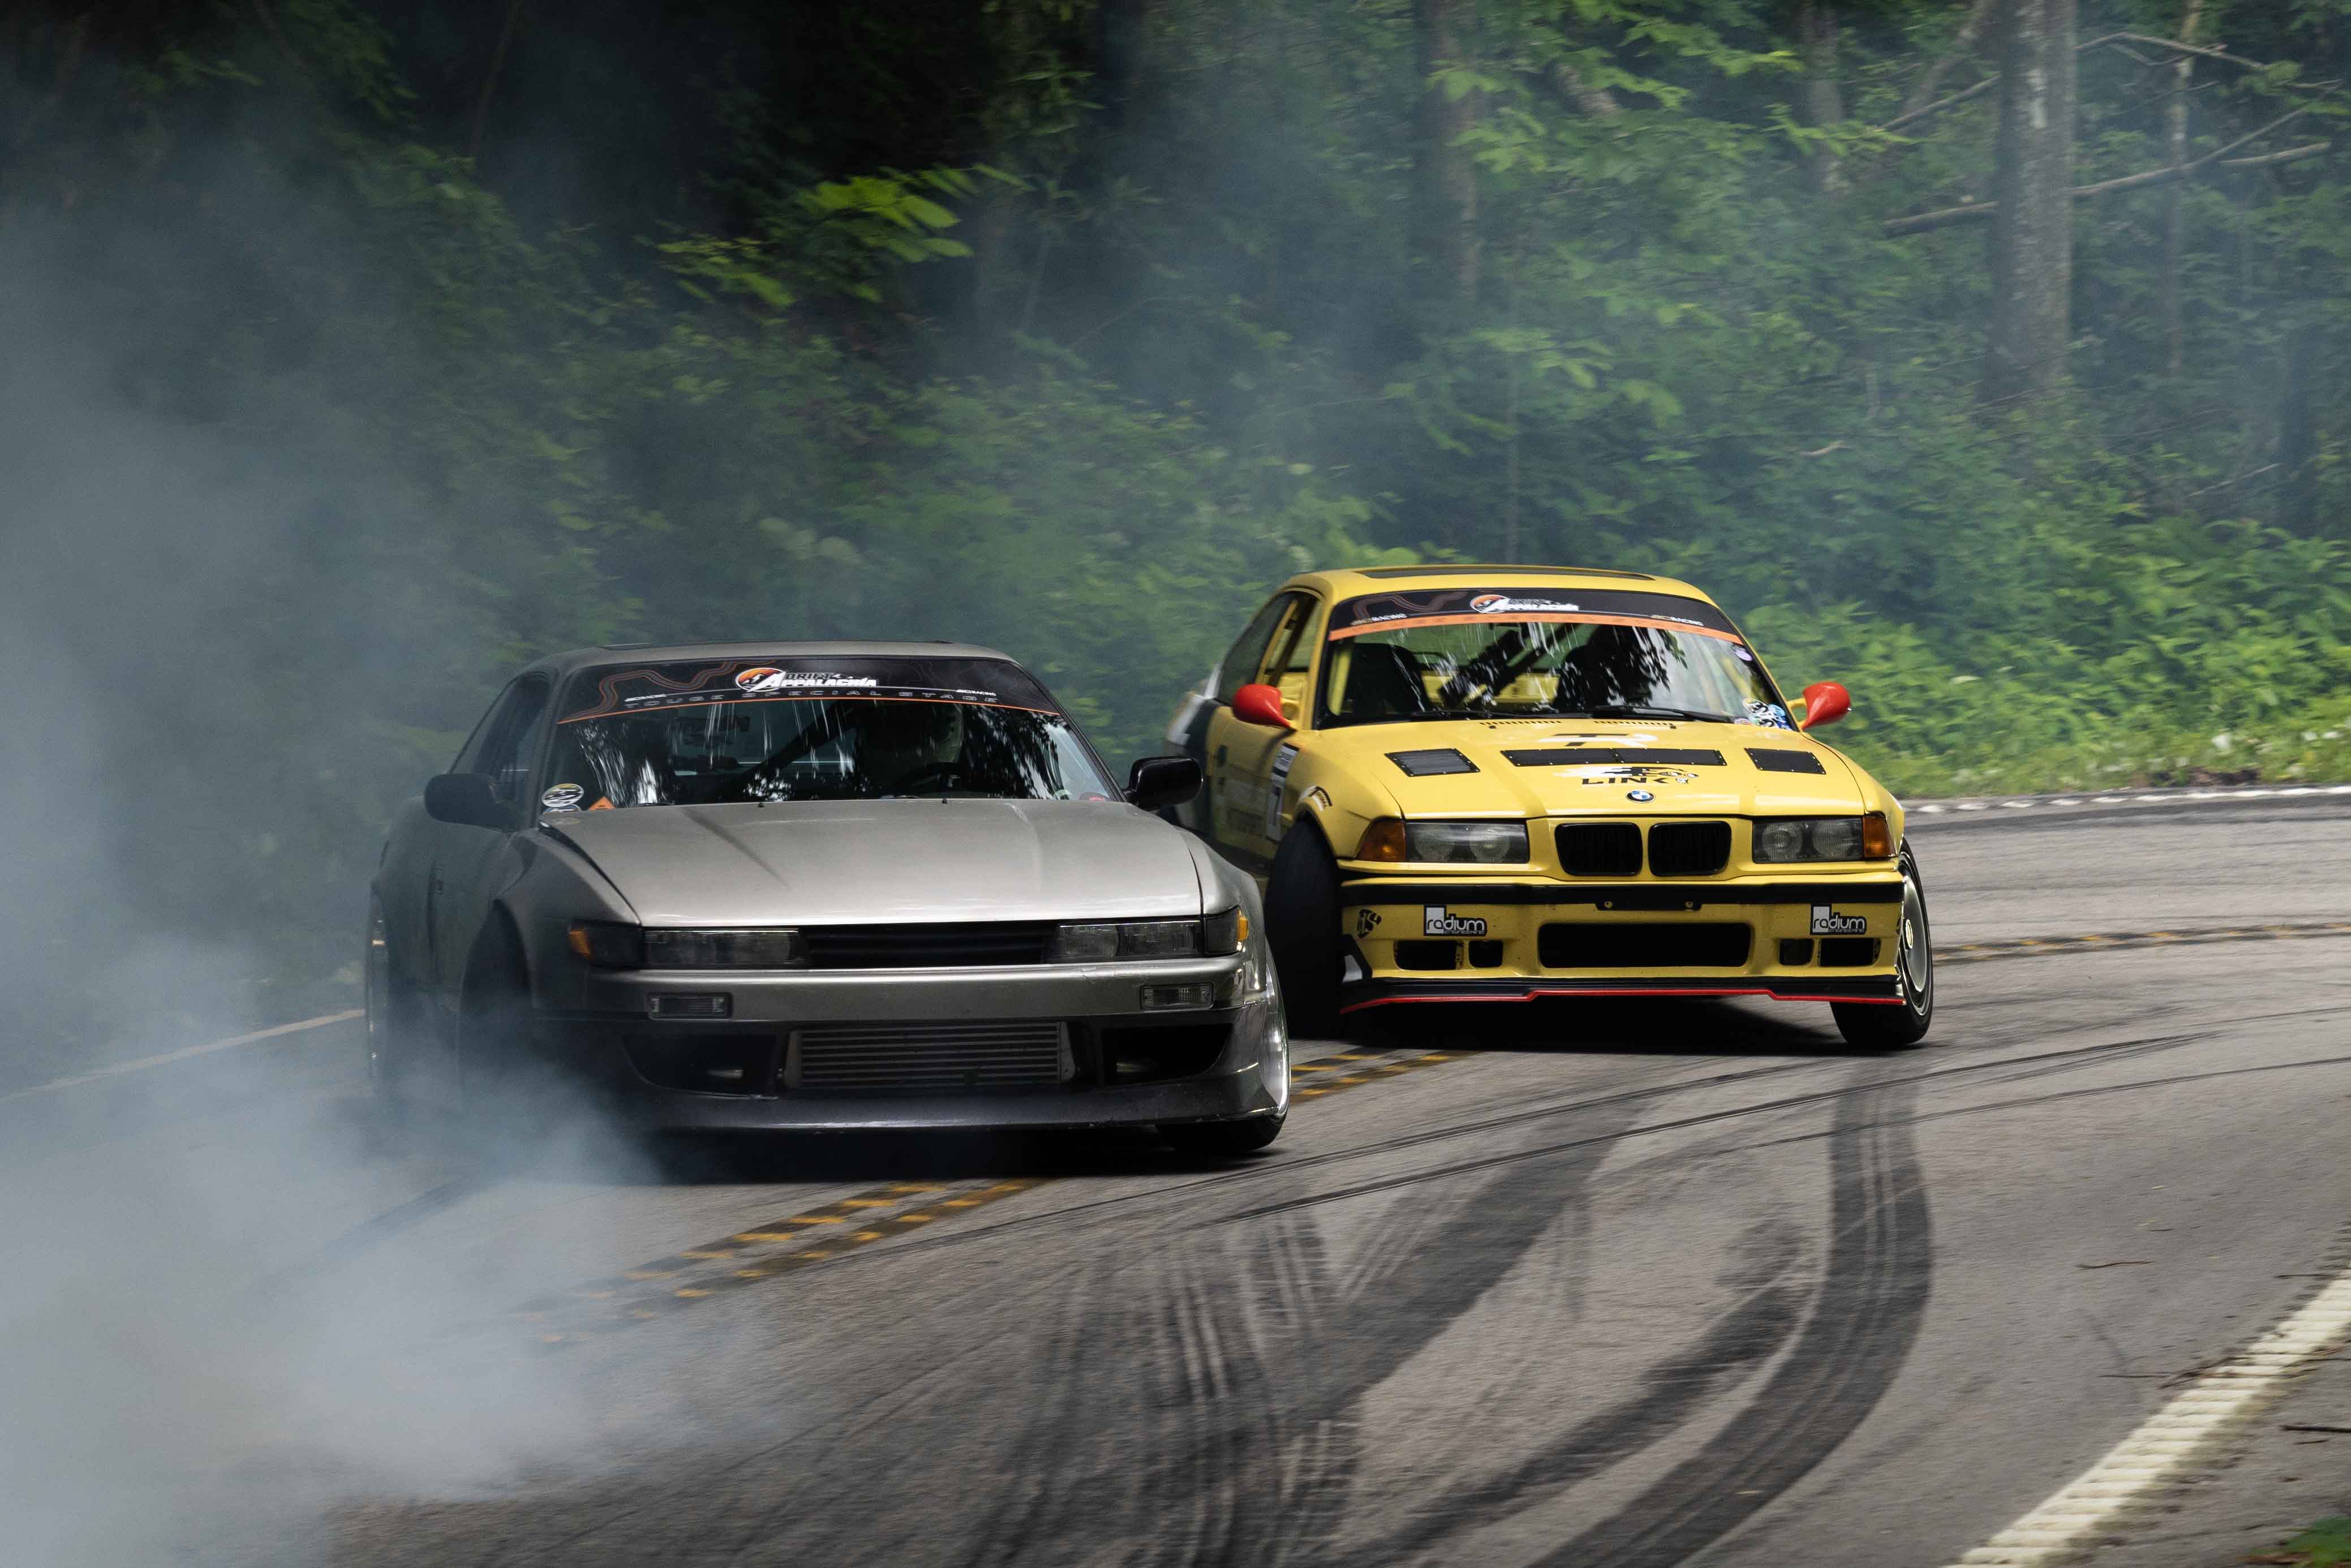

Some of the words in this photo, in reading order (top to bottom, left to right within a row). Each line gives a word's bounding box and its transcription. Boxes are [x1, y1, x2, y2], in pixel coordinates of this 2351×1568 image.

[899, 691, 998, 703] STAGE
[1427, 915, 1485, 930] radium
[1813, 914, 1865, 929] radium
